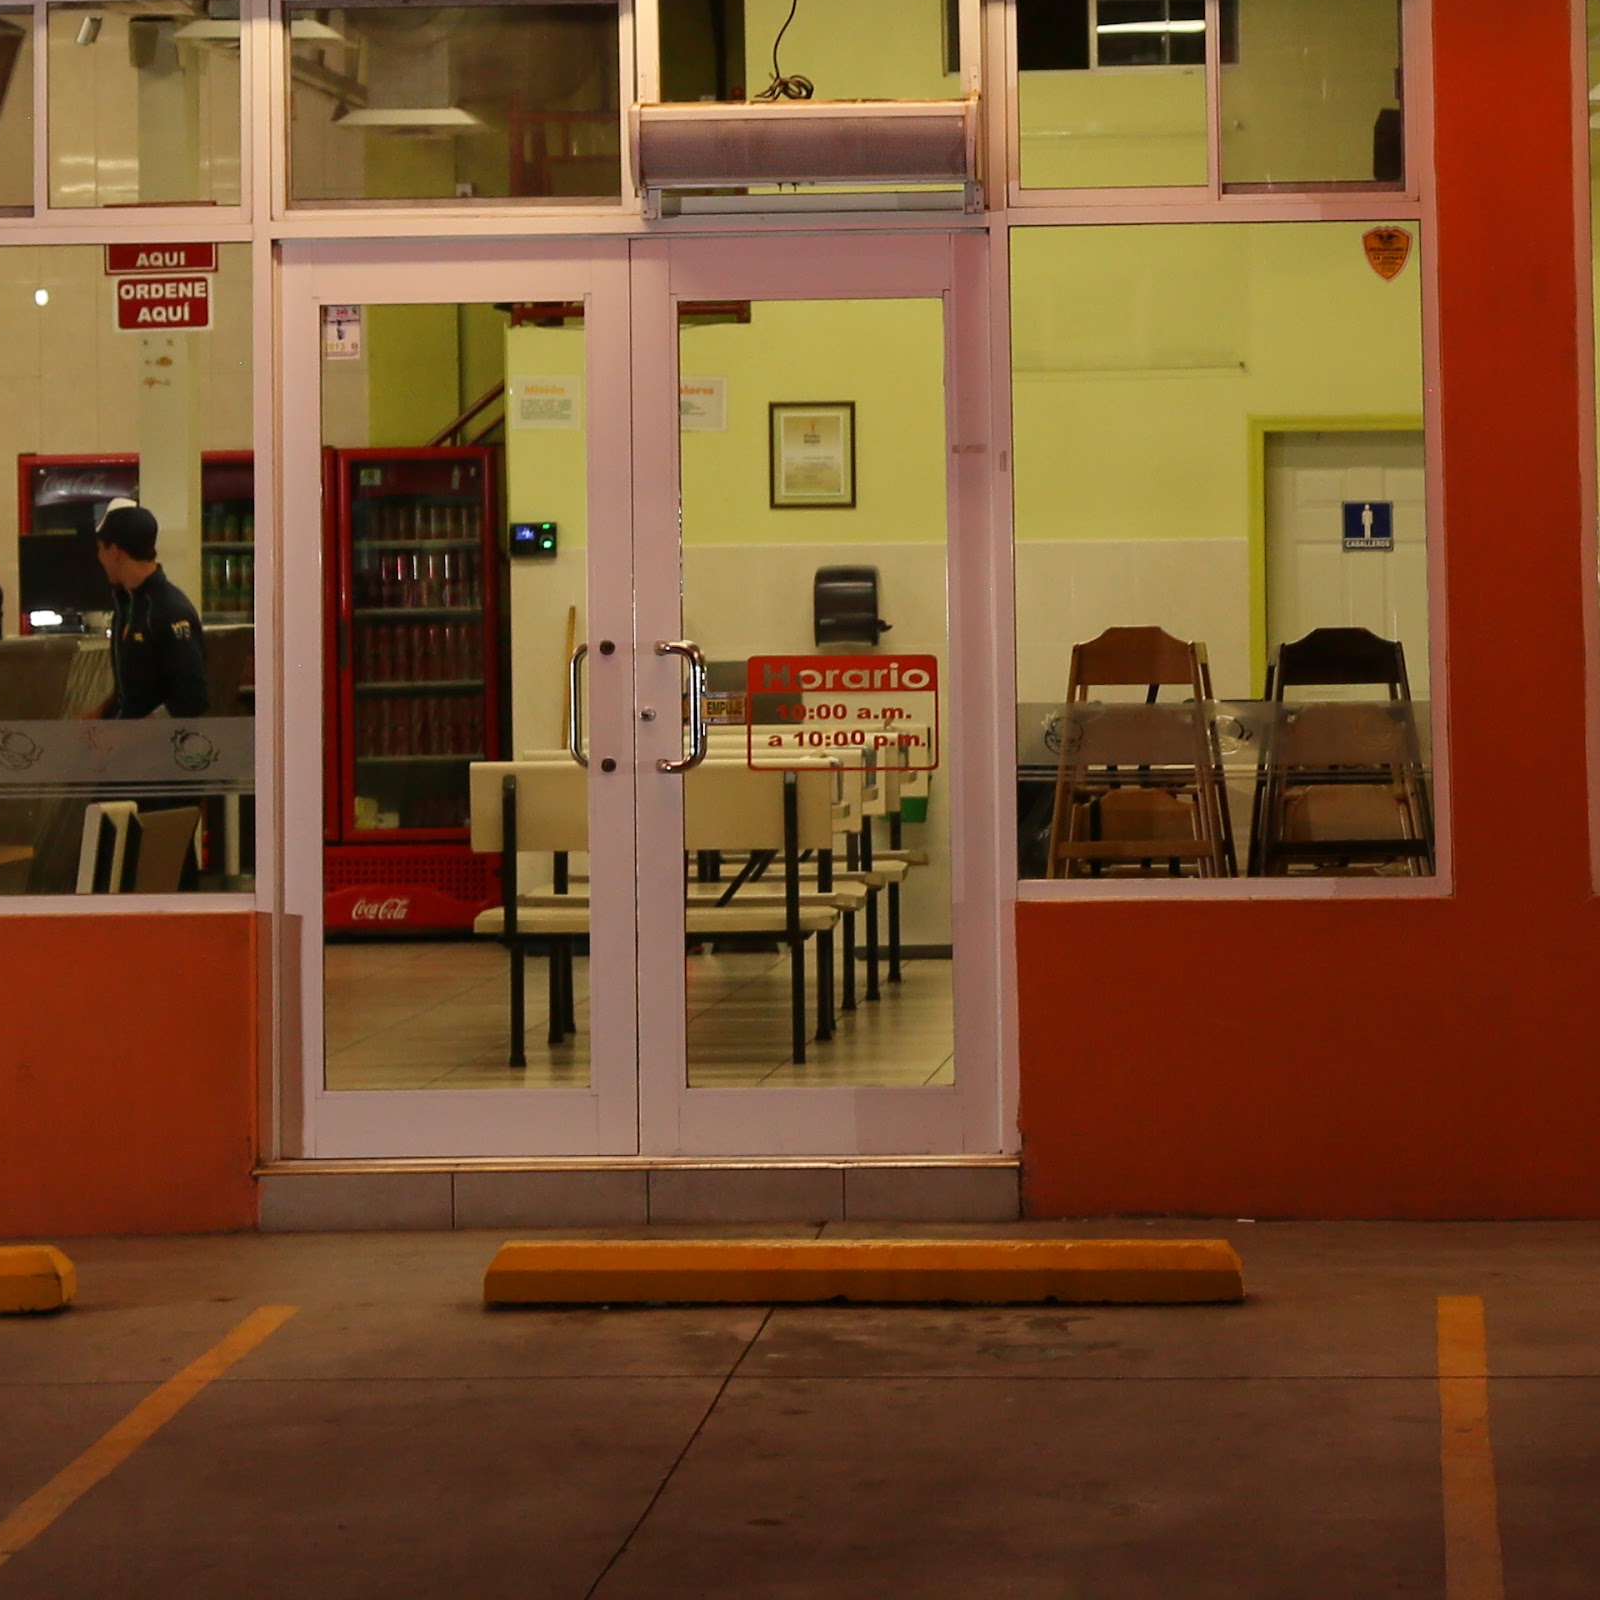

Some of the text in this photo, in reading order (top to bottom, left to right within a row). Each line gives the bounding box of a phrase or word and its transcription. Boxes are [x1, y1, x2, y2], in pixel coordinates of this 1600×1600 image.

[136, 251, 186, 267] AQUI
[120, 282, 207, 300] ORDENE
[137, 302, 190, 322] AQUÍ
[763, 662, 930, 689] Horario
[776, 704, 912, 720] 10:00 a.m.
[768, 730, 927, 750] a 10:00 p.m.
